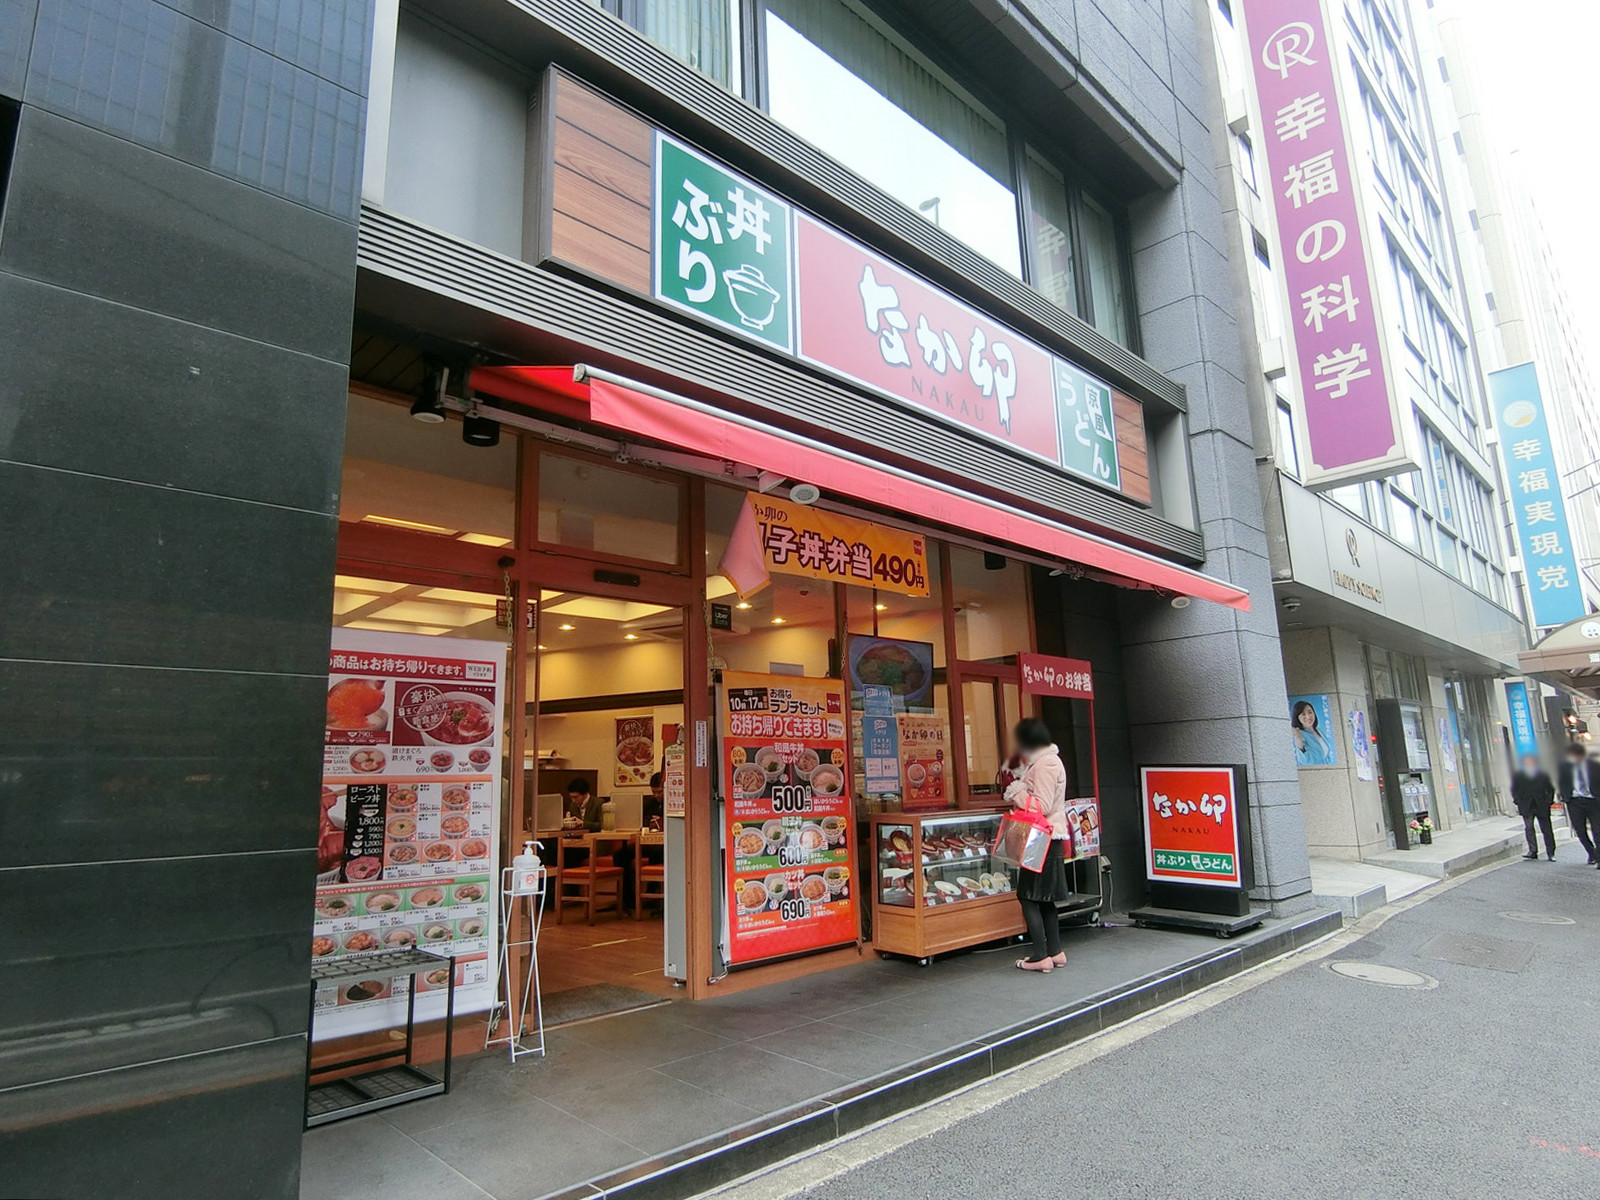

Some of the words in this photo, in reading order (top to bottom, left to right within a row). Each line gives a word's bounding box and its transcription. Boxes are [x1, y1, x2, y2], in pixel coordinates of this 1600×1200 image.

[1275, 92, 1371, 399] 幸福の科学
[859, 264, 1017, 436] なか卯
[911, 374, 986, 424] NAKAU
[1059, 372, 1112, 481] うどん
[1511, 438, 1570, 590] 幸福実現党
[874, 553, 926, 589] 490円
[1023, 664, 1092, 692] なか卯のお弁当
[770, 699, 826, 715] ランチセット
[350, 795, 381, 803] ビーフ丼
[351, 785, 381, 794] ロースト
[1152, 791, 1227, 826] なか卯
[1172, 826, 1210, 835] NAKAU
